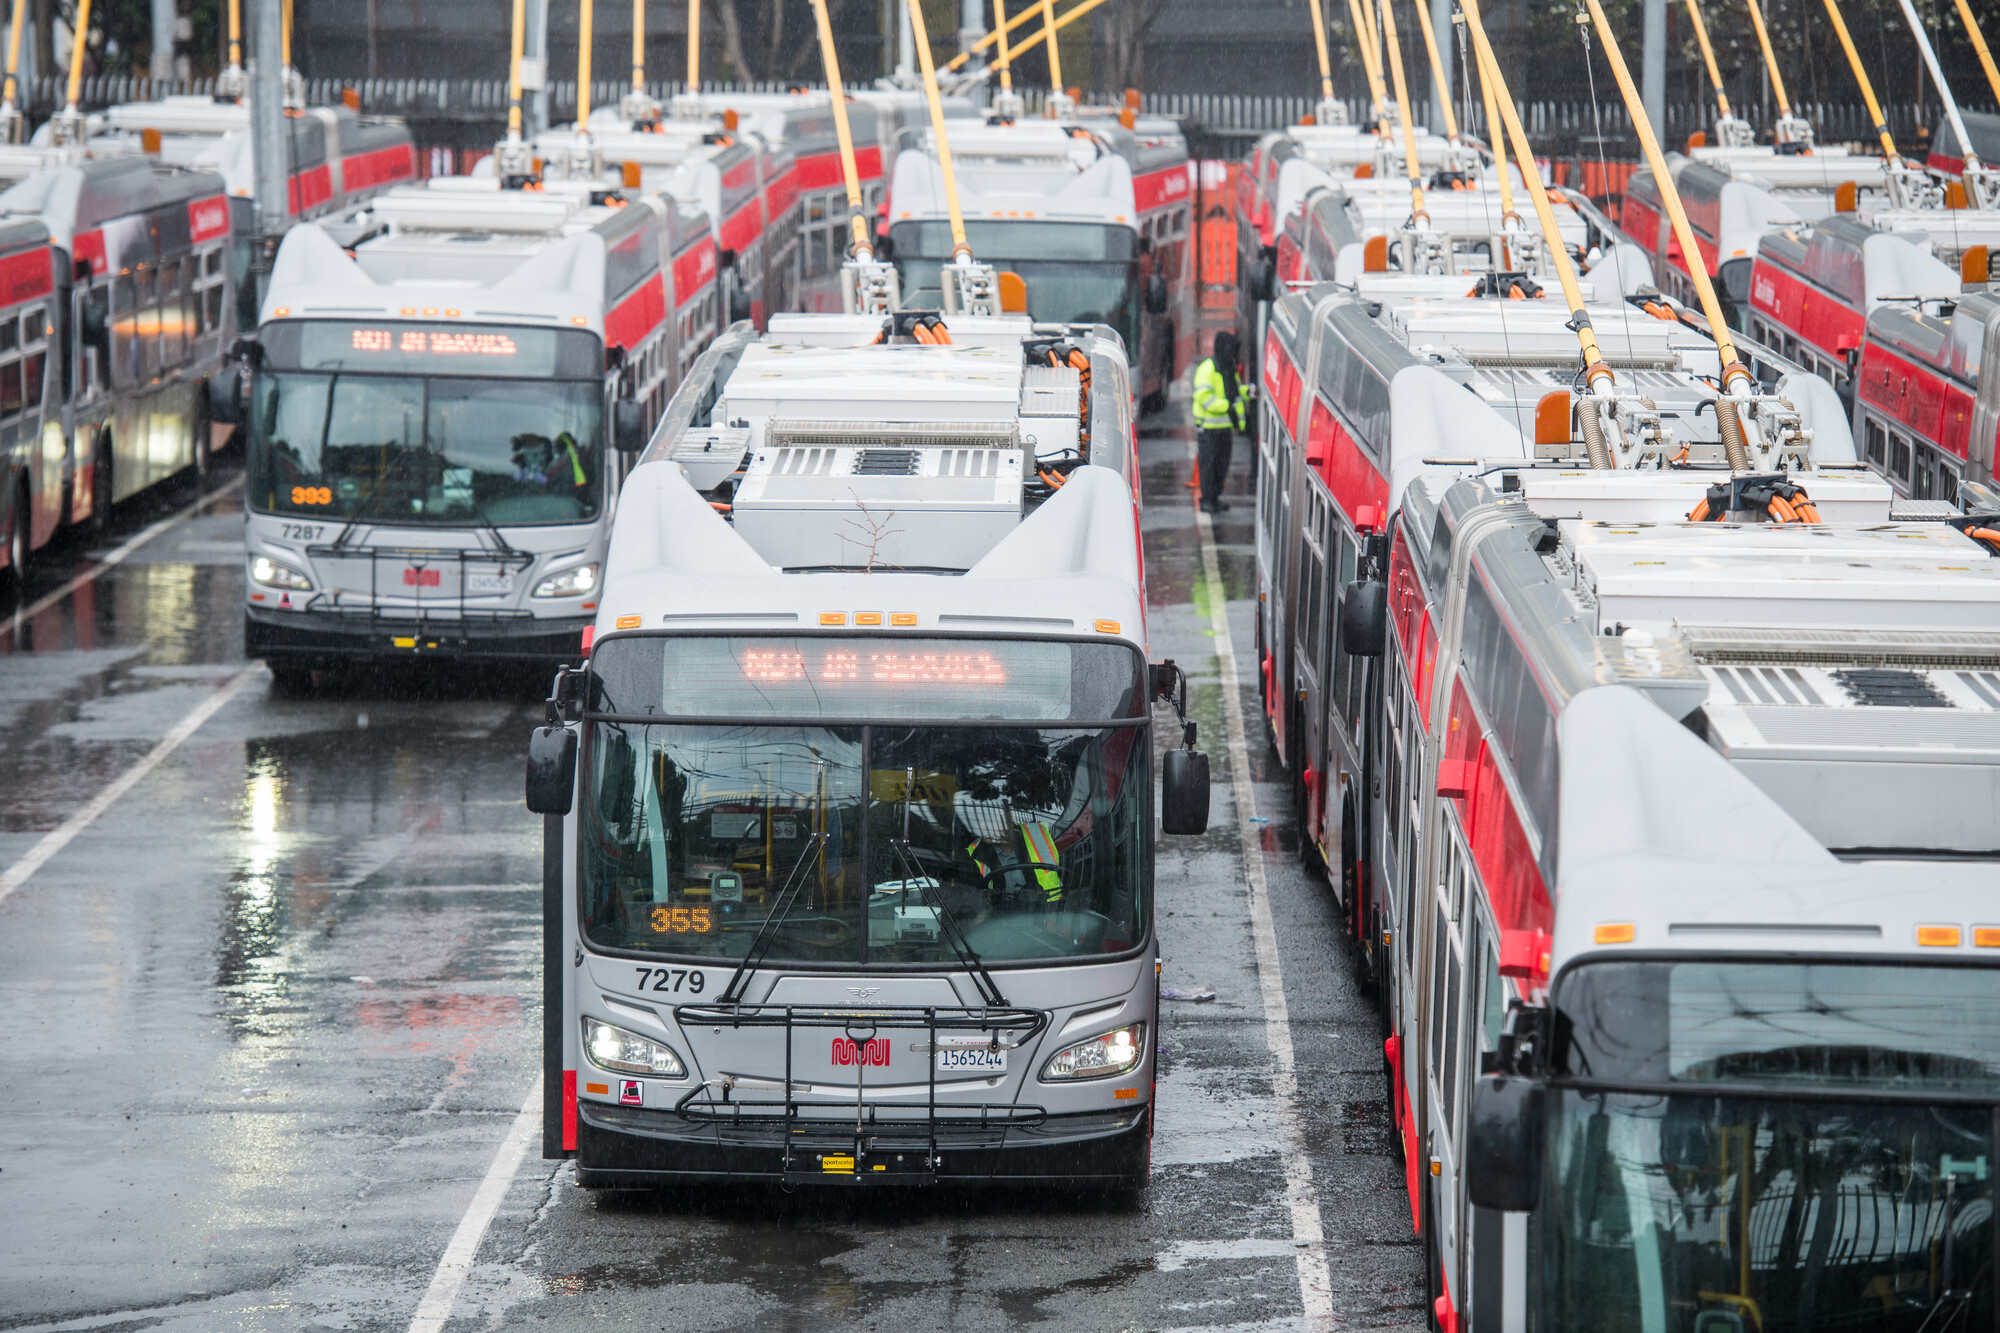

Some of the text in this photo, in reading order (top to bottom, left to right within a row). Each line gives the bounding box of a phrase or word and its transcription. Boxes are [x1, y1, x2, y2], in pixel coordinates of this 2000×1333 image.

[291, 487, 332, 505] 393
[282, 523, 324, 540] 7287
[746, 653, 1002, 680] NOT IN SERVICE
[651, 908, 711, 932] 355
[635, 967, 705, 994] 7279
[942, 1049, 1002, 1066] 1565244
